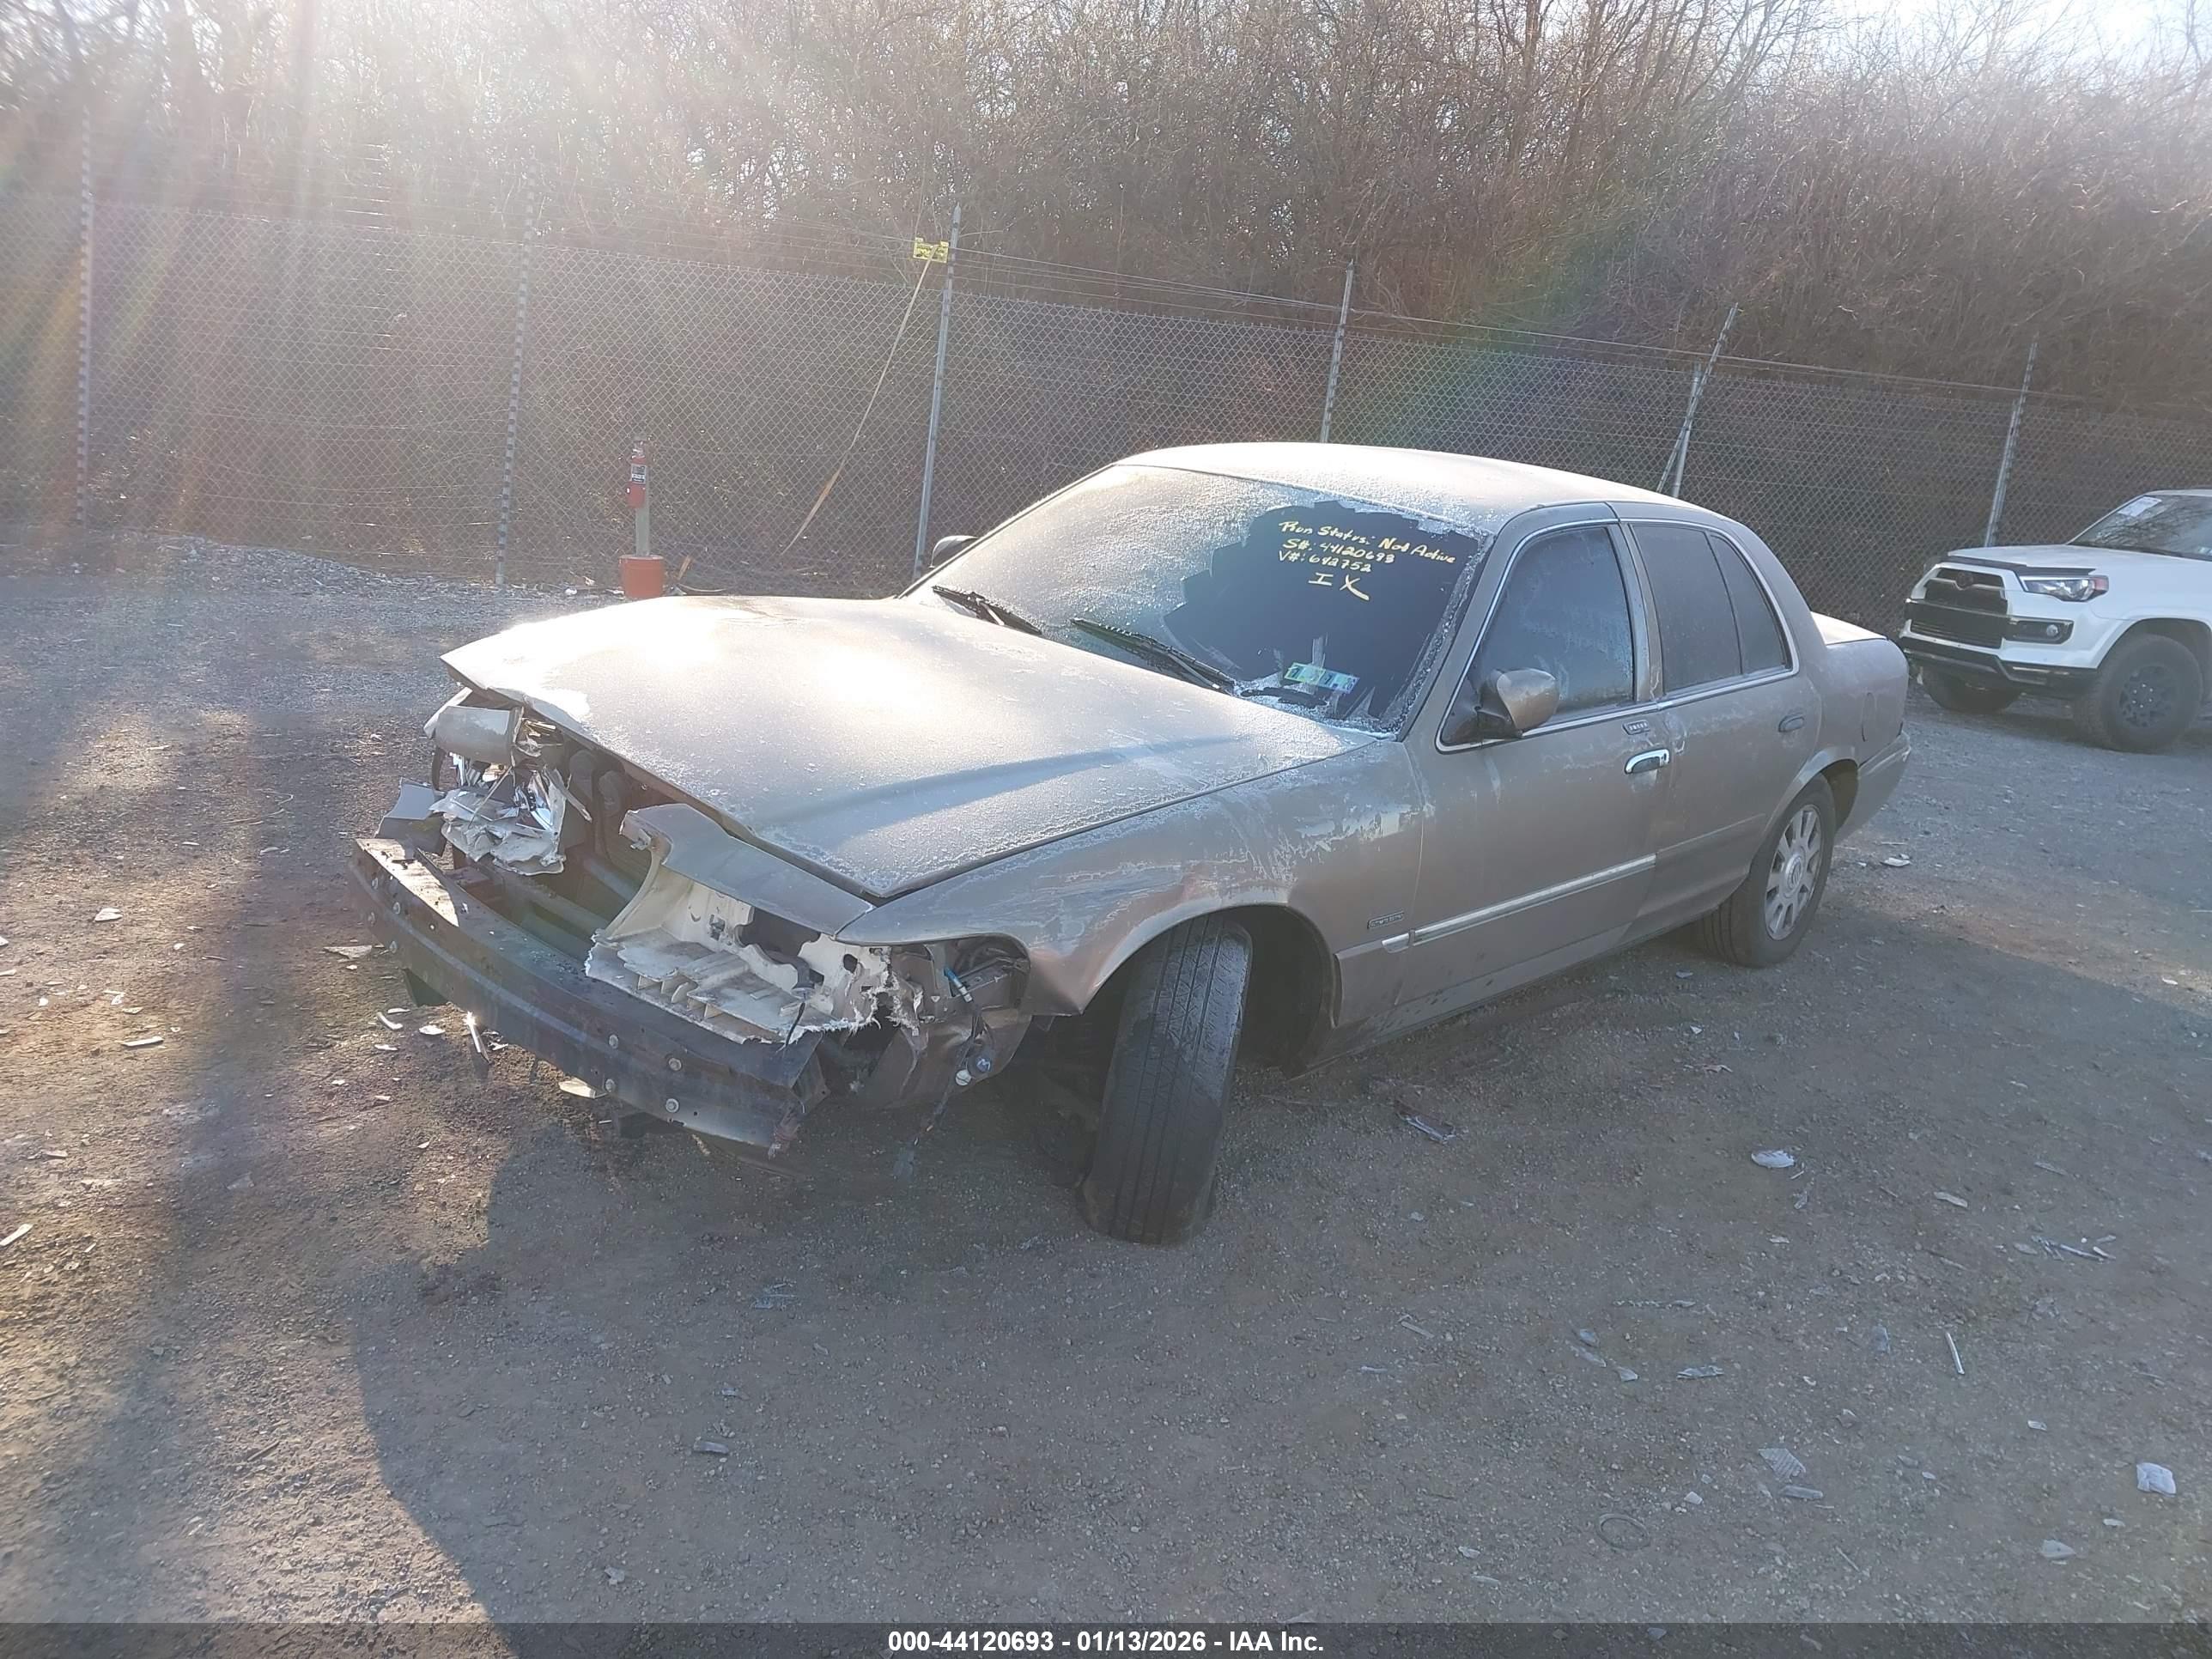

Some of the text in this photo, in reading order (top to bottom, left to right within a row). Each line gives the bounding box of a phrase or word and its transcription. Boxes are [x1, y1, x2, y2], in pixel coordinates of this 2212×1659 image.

[1278, 520, 1313, 535] Run
[1377, 538, 1411, 553] Not
[1411, 544, 1457, 564] Active
[1319, 542, 1395, 564] 44120693
[1308, 554, 1372, 574] 642752
